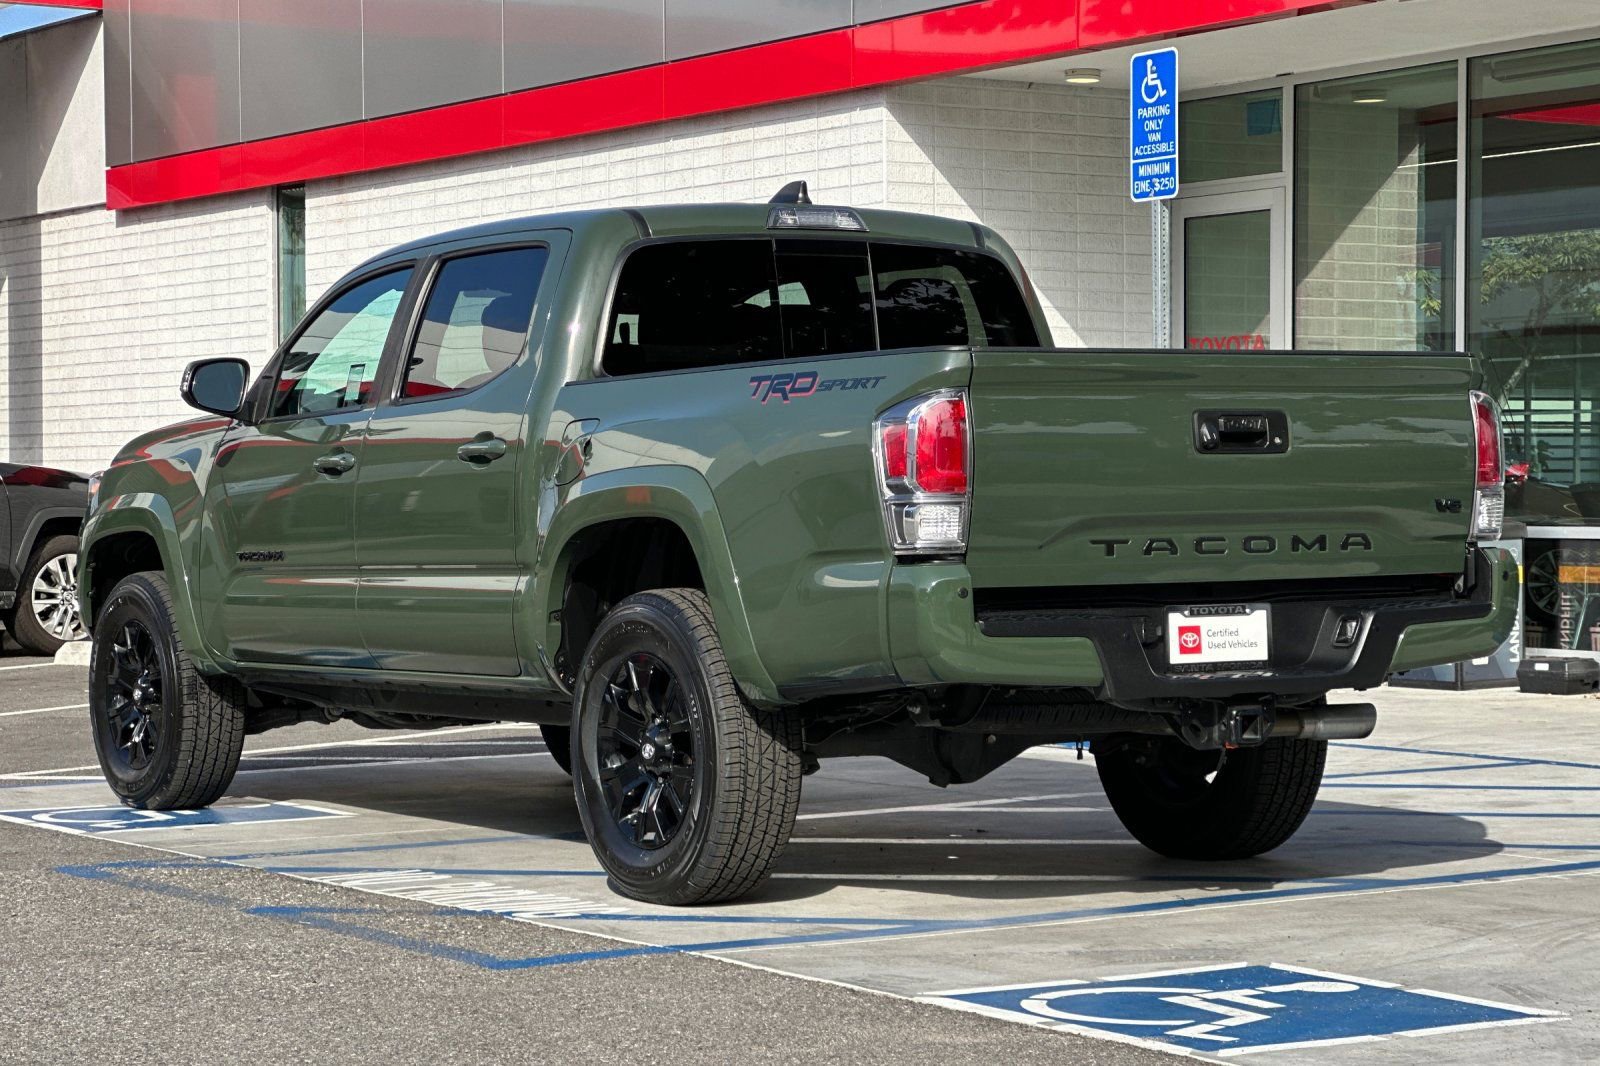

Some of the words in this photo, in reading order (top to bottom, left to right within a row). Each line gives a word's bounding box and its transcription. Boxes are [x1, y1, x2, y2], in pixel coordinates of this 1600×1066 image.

[1138, 104, 1170, 119] PARKING
[1144, 119, 1163, 131] ONLY
[1148, 132, 1161, 142] VAN
[1135, 142, 1174, 156] ACCESSIBLE
[1138, 162, 1170, 177] MINIMUM
[1153, 177, 1175, 191] $250
[1188, 335, 1265, 350] TOYOTA
[749, 371, 819, 405] TRD
[817, 376, 887, 392] SPORT
[1435, 498, 1462, 513] V6
[1089, 533, 1373, 557] TACOMA
[1191, 605, 1244, 615] TOYOTA
[1207, 628, 1239, 637] Certified
[1207, 640, 1226, 649] Used
[1228, 639, 1258, 648] Vehicles
